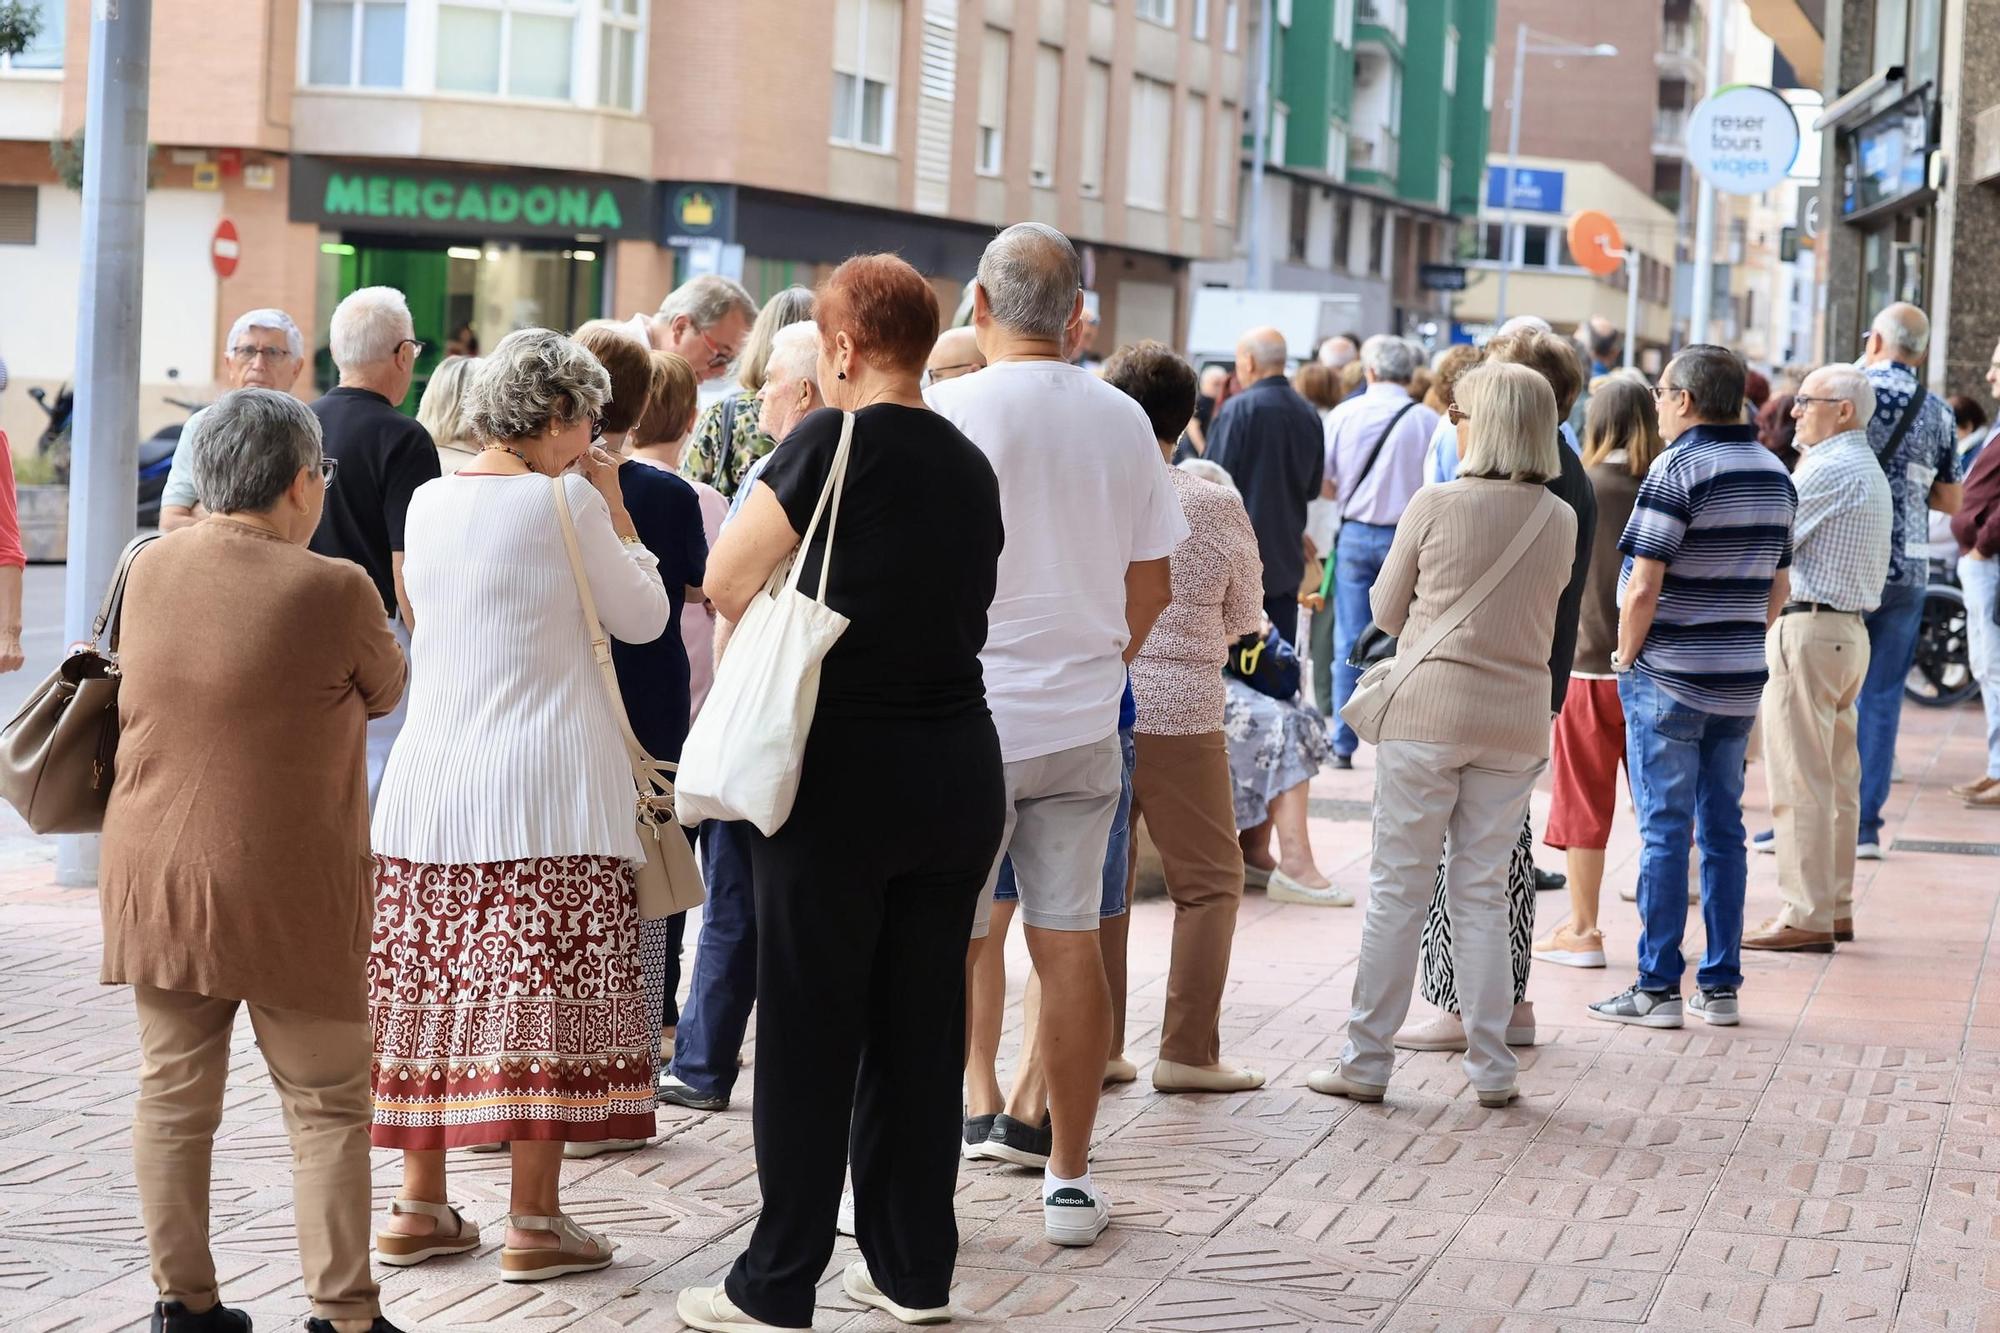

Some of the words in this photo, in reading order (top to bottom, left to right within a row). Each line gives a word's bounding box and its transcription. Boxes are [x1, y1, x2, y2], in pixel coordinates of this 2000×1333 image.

[1711, 115, 1765, 131] reser
[1711, 134, 1762, 151] tours
[1711, 155, 1769, 178] viajes
[324, 174, 622, 229] MERCADONA
[1055, 1196, 1085, 1205] Reebok
